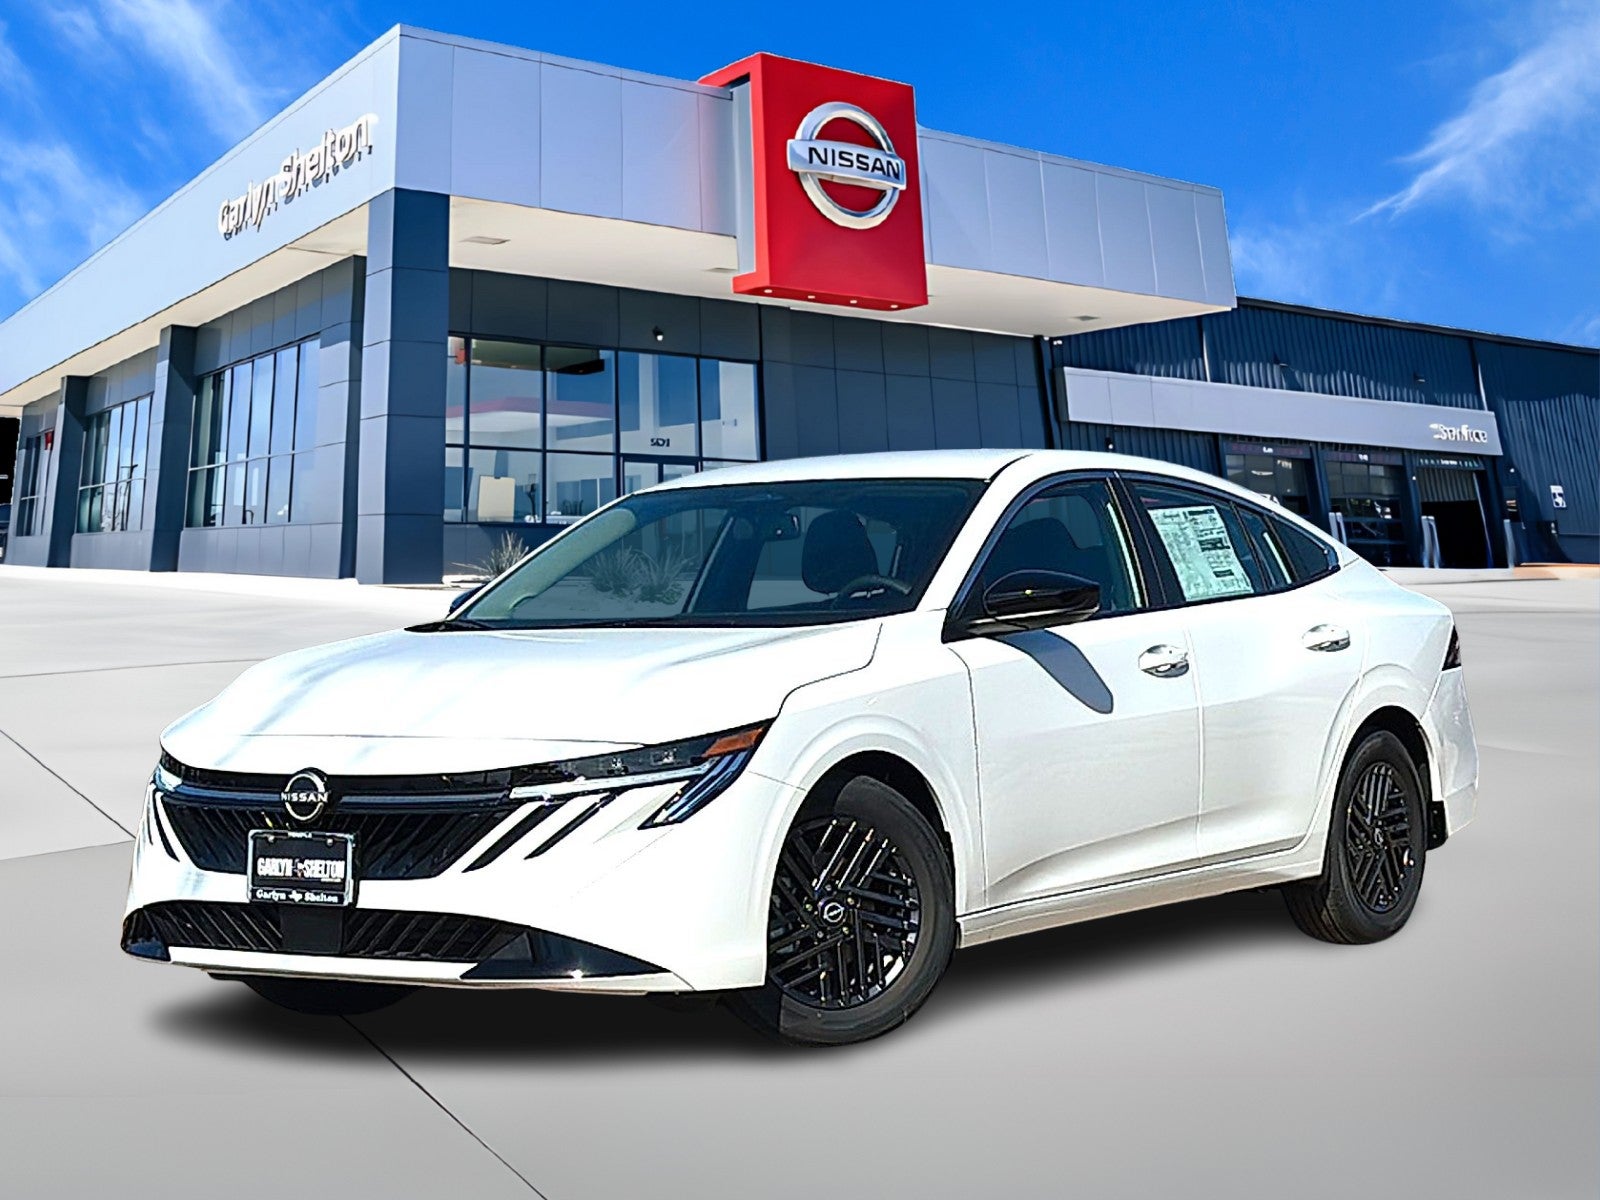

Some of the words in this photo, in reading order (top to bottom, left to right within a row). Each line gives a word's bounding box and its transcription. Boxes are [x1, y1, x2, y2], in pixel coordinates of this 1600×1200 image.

[279, 113, 379, 202] Shelton
[808, 146, 901, 180] NISSAN
[1429, 423, 1489, 443] Service
[281, 791, 329, 803] NISSAN
[303, 858, 346, 879] SHELTON
